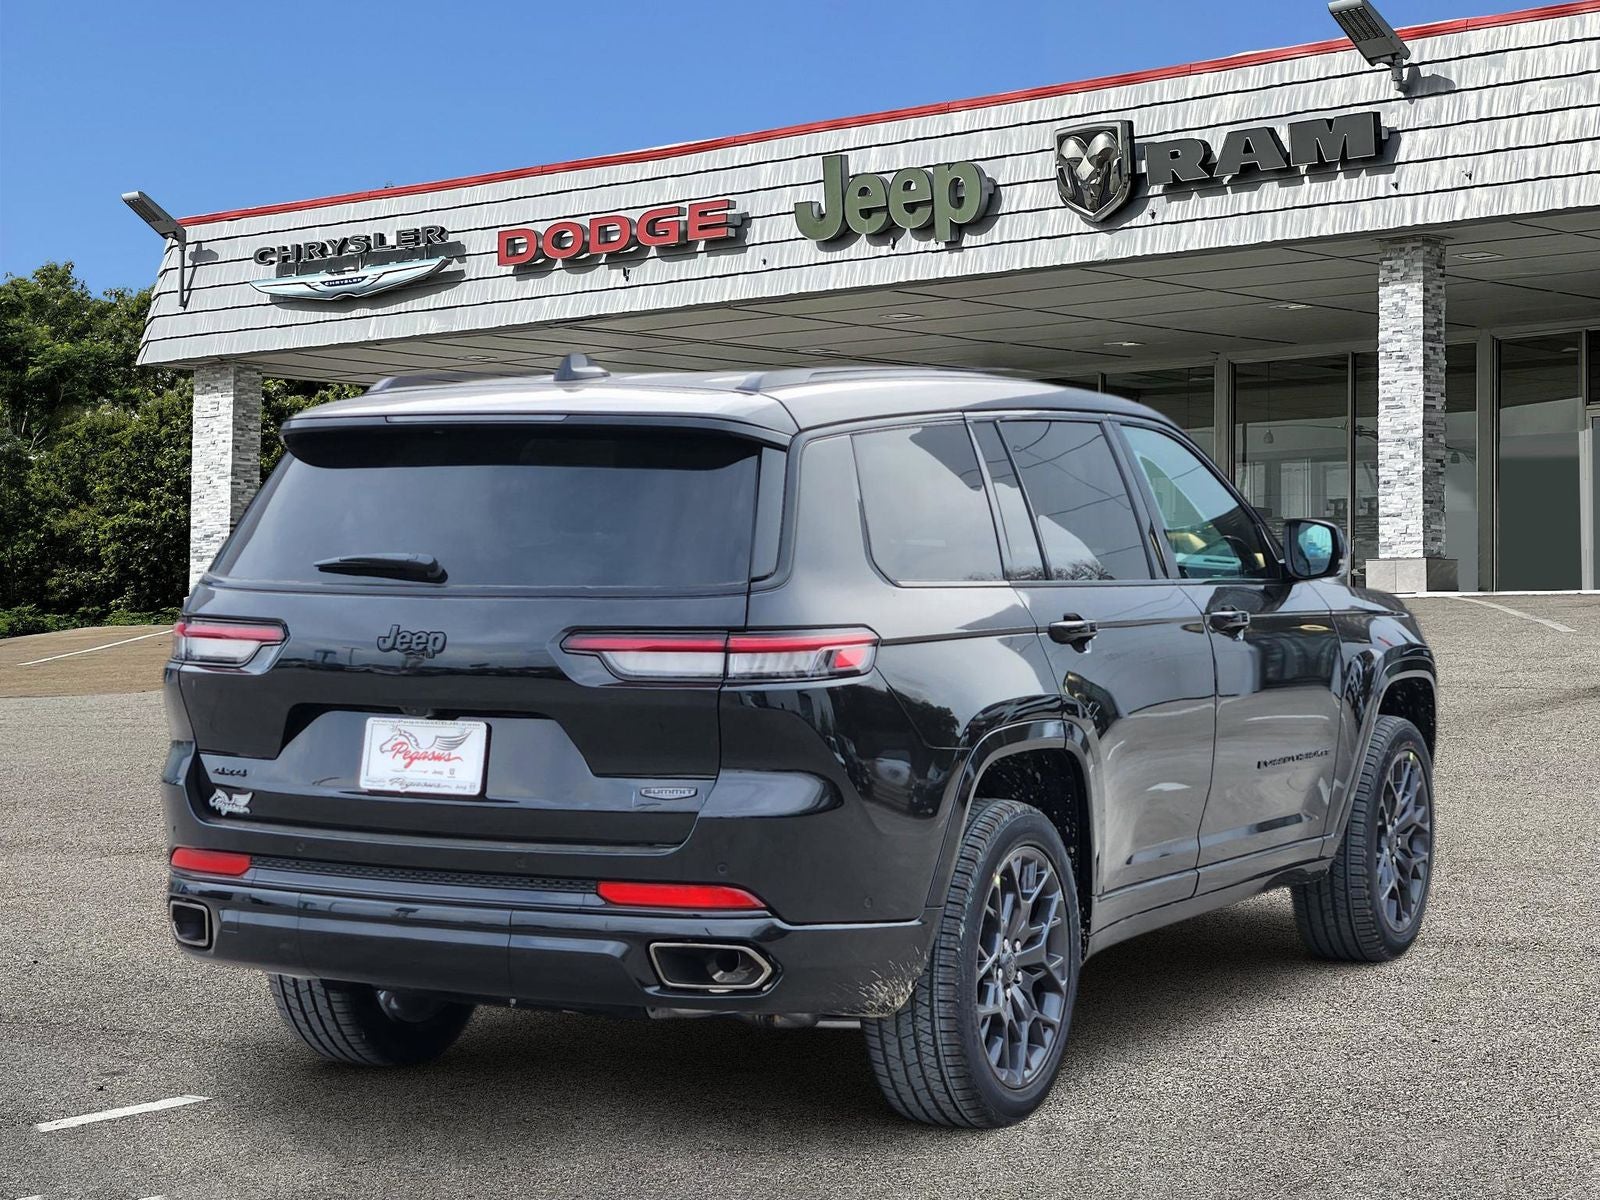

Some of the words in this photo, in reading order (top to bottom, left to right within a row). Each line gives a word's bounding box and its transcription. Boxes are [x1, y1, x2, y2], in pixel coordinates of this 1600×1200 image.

[1144, 111, 1382, 187] RAM
[795, 155, 986, 243] Jeep
[253, 225, 448, 266] CHRYSLER
[498, 199, 736, 267] DODGE
[324, 277, 363, 286] CHRYSLER
[377, 624, 447, 659] Jeep
[391, 741, 464, 769] Pegasus
